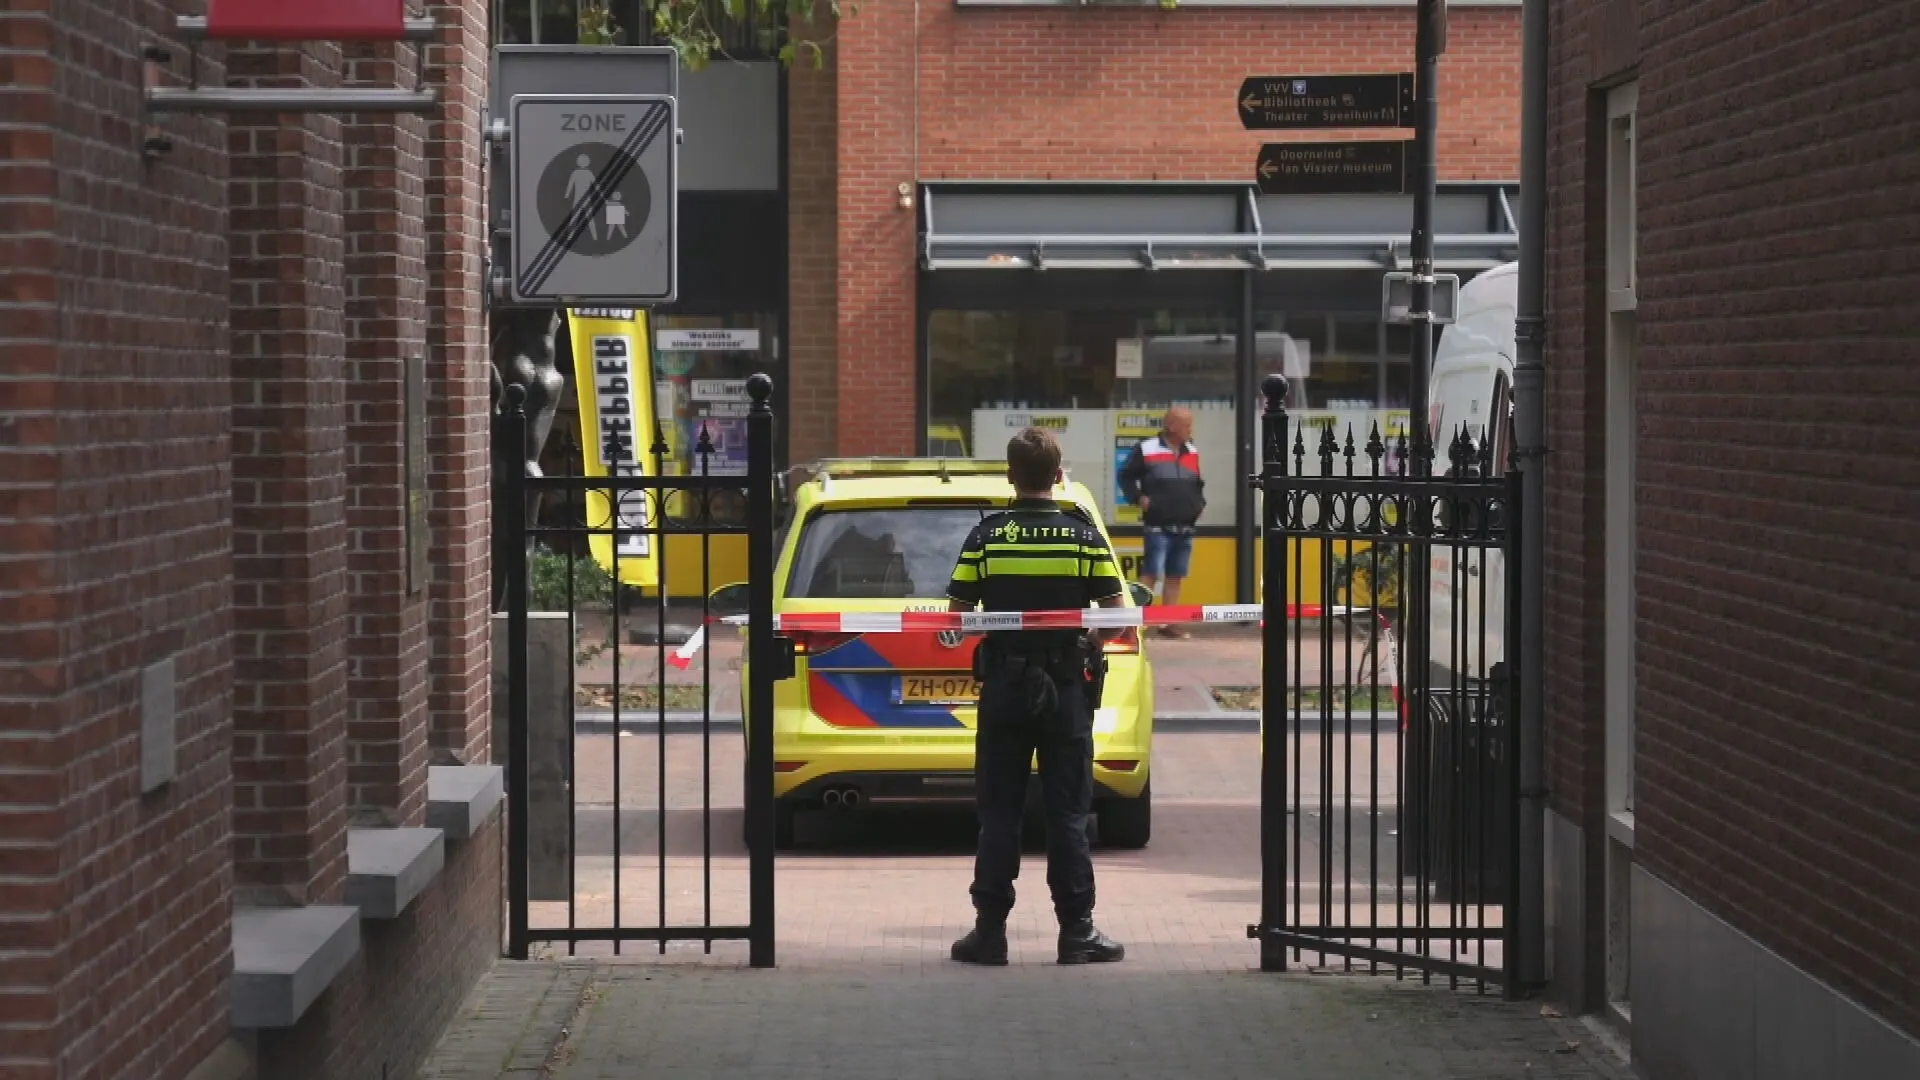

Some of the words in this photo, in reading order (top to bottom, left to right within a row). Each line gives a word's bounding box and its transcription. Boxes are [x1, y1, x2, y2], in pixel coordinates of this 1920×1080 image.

[1264, 82, 1289, 93] VVV
[1264, 95, 1337, 107] Bibliotheek
[1264, 110, 1308, 121] Theater
[560, 113, 626, 131] ZONE
[1303, 162, 1338, 174] Visser
[1343, 162, 1392, 174] museum
[995, 525, 1070, 540] POLITIE
